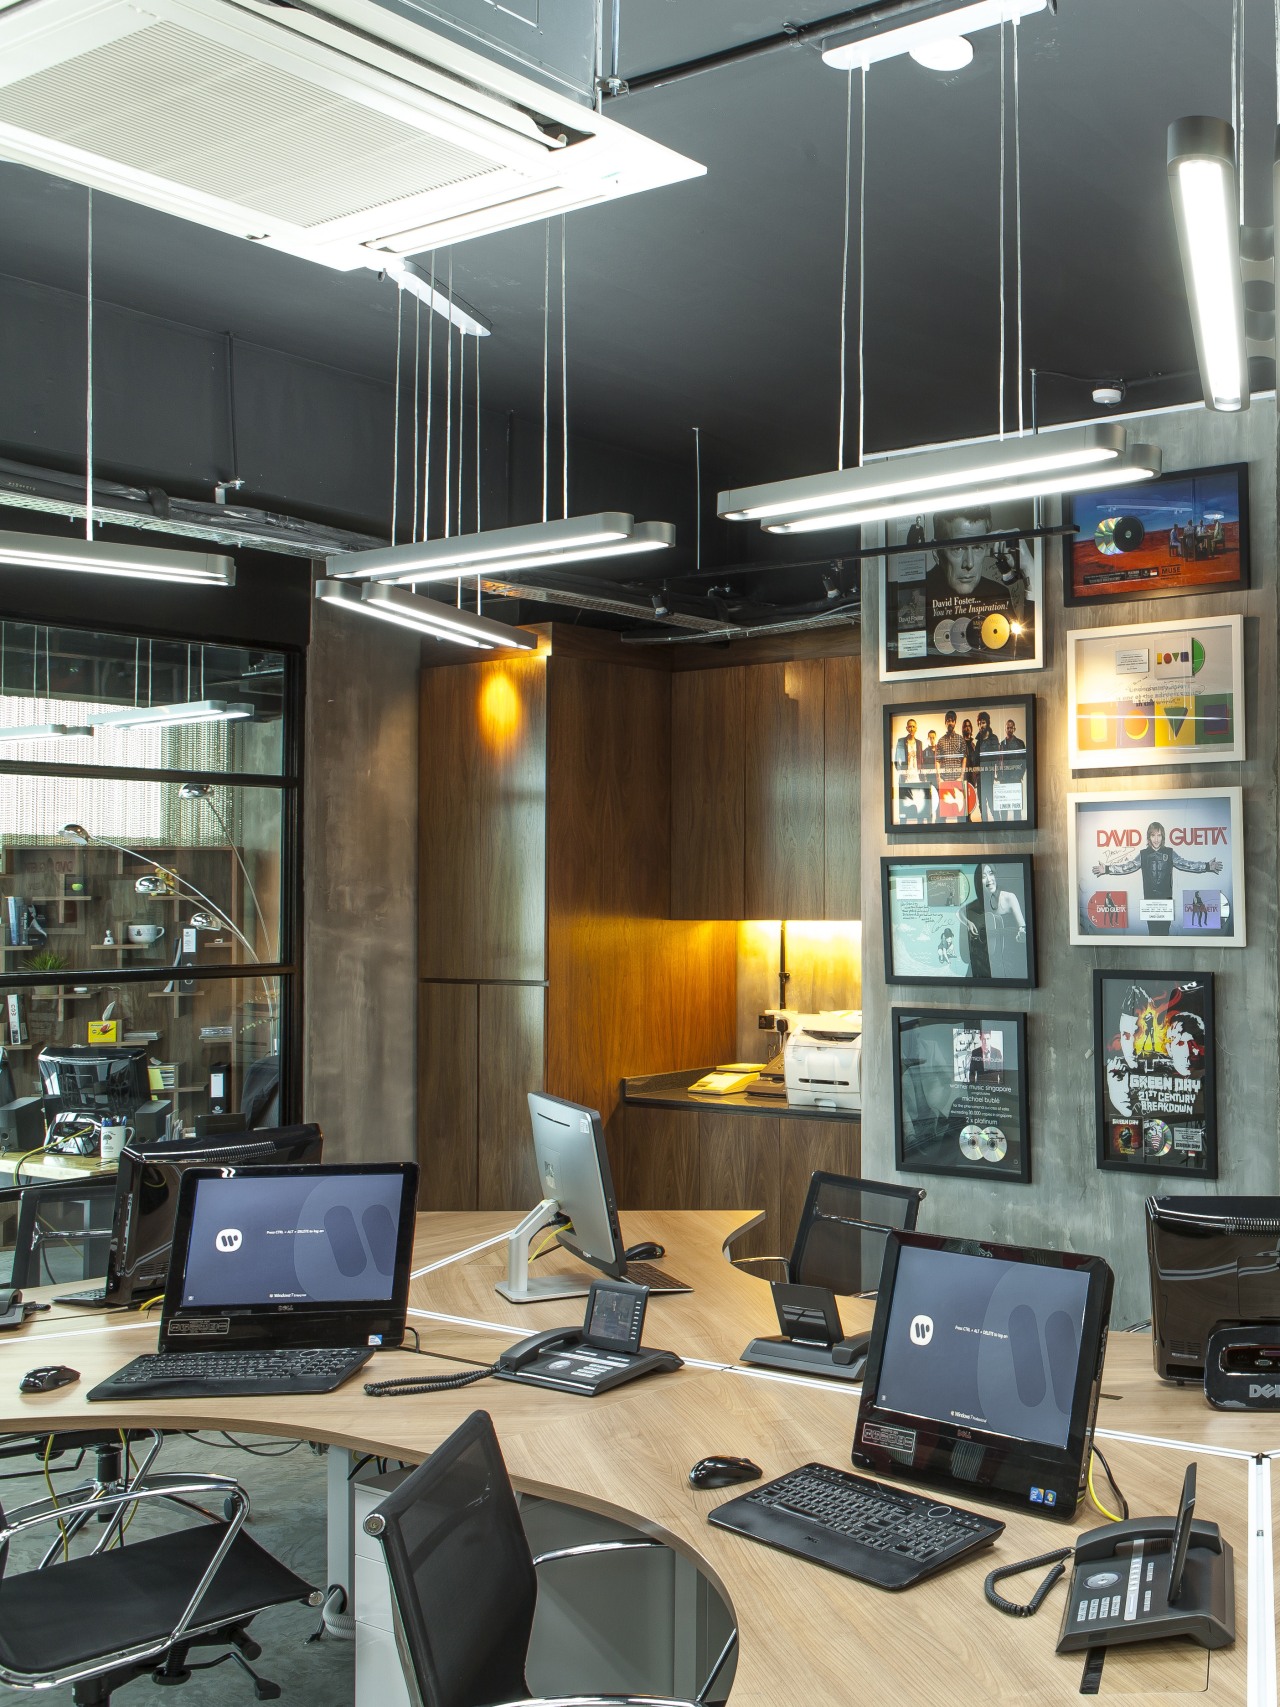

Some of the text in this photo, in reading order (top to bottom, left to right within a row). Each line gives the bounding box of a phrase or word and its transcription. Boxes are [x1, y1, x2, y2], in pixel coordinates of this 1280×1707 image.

[1161, 566, 1182, 576] MUSE
[932, 596, 982, 608] David Foster...
[933, 600, 1010, 617] You're The Inspiration!
[1096, 826, 1228, 848] DAVID GUETTA
[1096, 905, 1127, 913] DAVID GUETTA
[985, 1084, 1012, 1093] singapore
[1129, 1074, 1201, 1093] GREEN DAY
[961, 1095, 984, 1103] michael
[1158, 1091, 1196, 1104] CENTURY
[1140, 1100, 1194, 1115] BREAKDOWN
[974, 1117, 998, 1126] platinum
[957, 1428, 972, 1440] DELL
